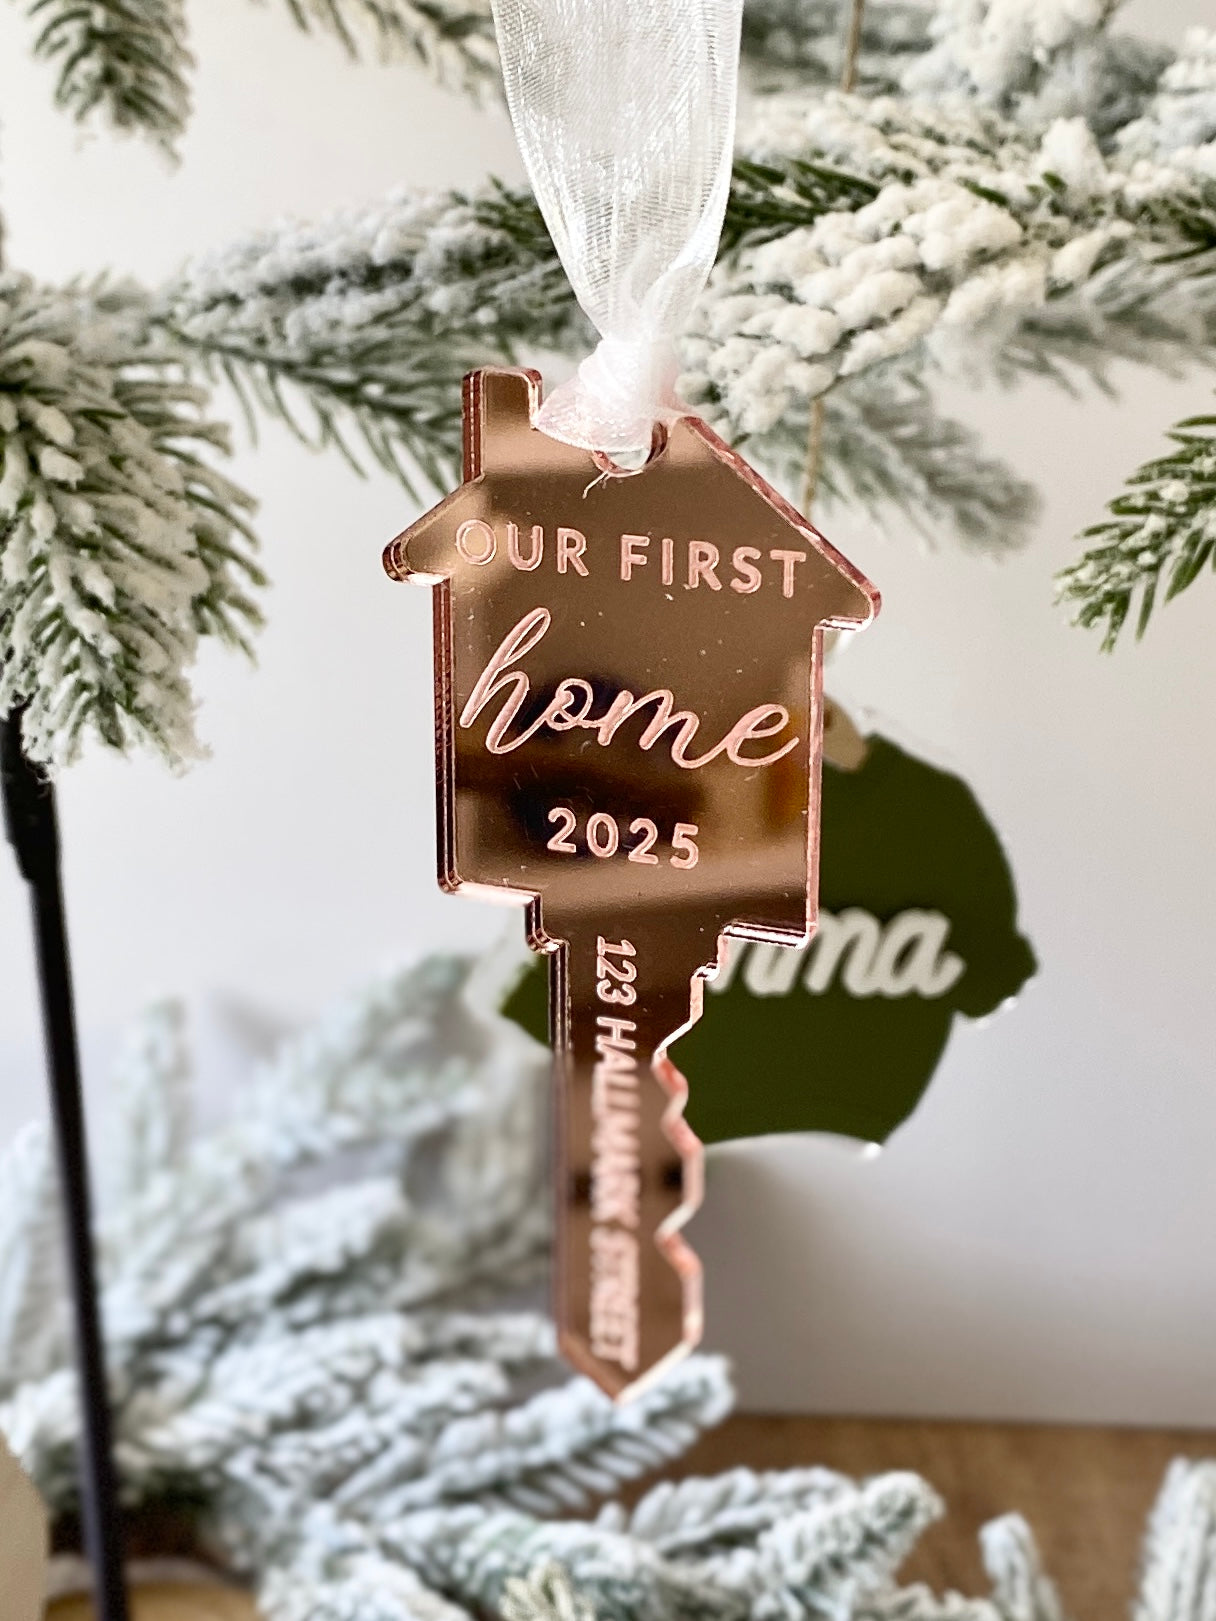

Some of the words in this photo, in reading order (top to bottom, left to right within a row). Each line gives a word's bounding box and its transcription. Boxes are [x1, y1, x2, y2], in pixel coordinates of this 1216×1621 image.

[455, 518, 590, 577] OUR
[619, 534, 807, 598] FIRST
[459, 607, 800, 769] home
[547, 806, 699, 870] 2025
[596, 934, 637, 1006] 123
